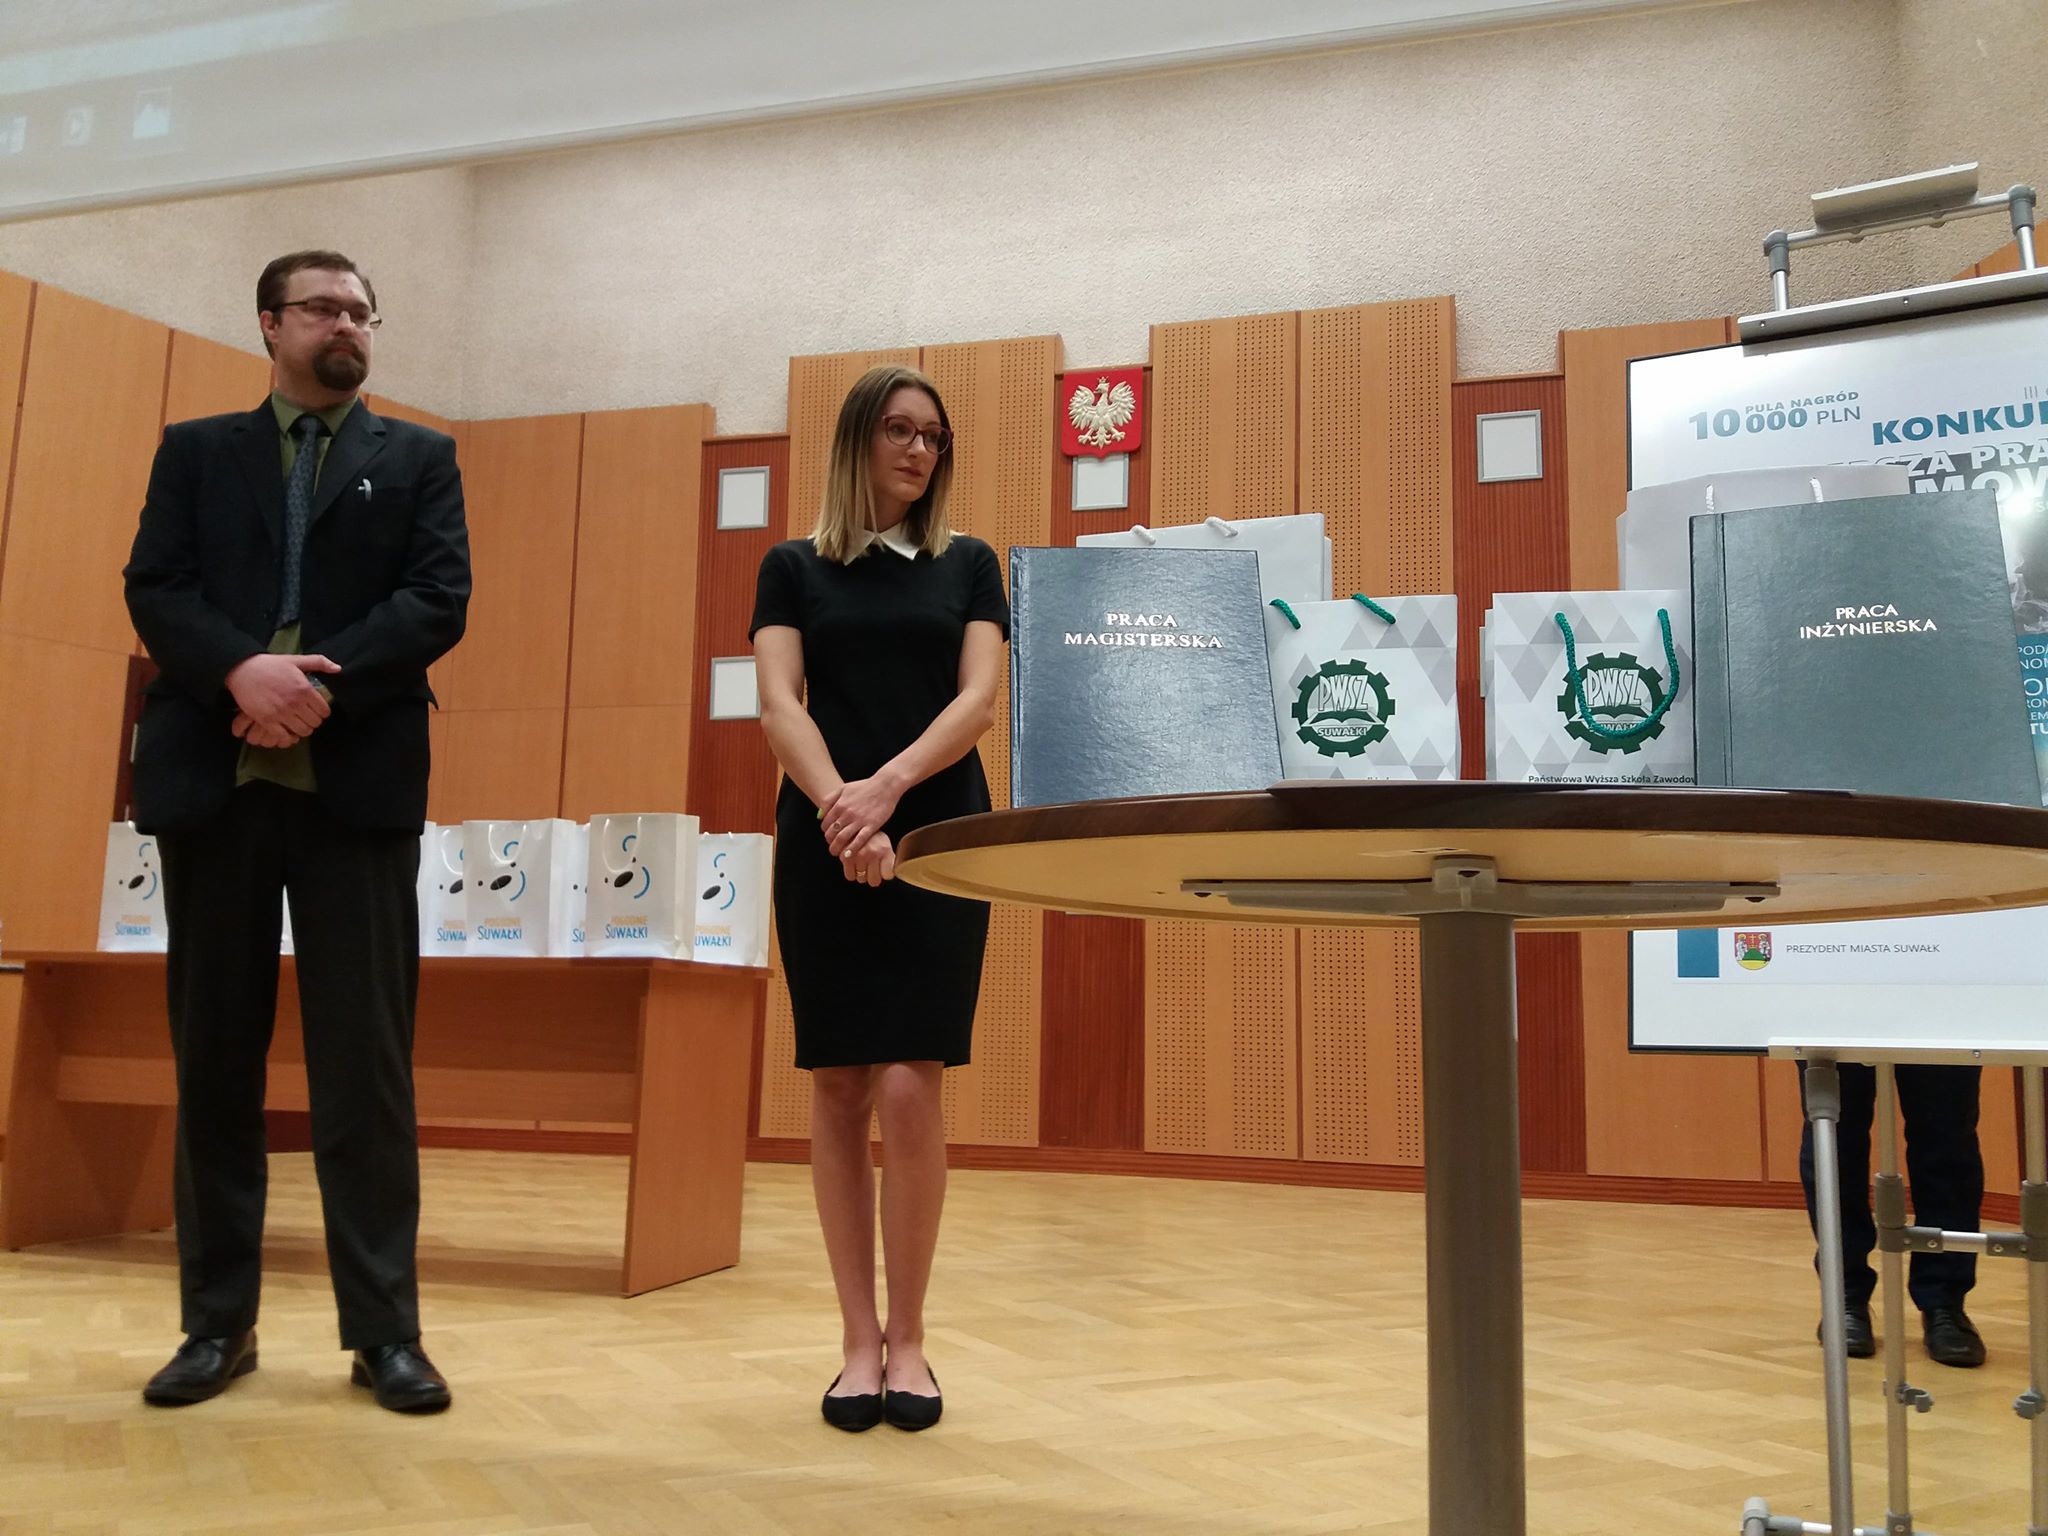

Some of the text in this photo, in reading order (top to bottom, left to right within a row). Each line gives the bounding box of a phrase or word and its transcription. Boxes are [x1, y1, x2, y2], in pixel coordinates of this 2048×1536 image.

[1745, 390, 1859, 415] PULA NAGRÓD
[1688, 406, 1861, 440] 10 000 PLN
[1835, 603, 1899, 620] PRACA
[1106, 613, 1179, 628] PRACA
[1800, 618, 1937, 640] INŻYNIERSKA
[1064, 632, 1224, 649] MAGISTERSKA
[1318, 674, 1368, 712] PWSZ
[1586, 668, 1642, 707] PWSZ
[1317, 726, 1368, 737] SUWAŁKI
[1528, 775, 1582, 784] Państwowa
[1585, 774, 1618, 784] Wyższa
[1621, 774, 1650, 784] Szkoła
[477, 925, 522, 941] SUWAŁKI
[605, 923, 648, 939] SUWAŁKI
[695, 935, 731, 947] UWAŁKI
[1786, 944, 1940, 953] PREZYDENT MIASTA SUWAŁK
